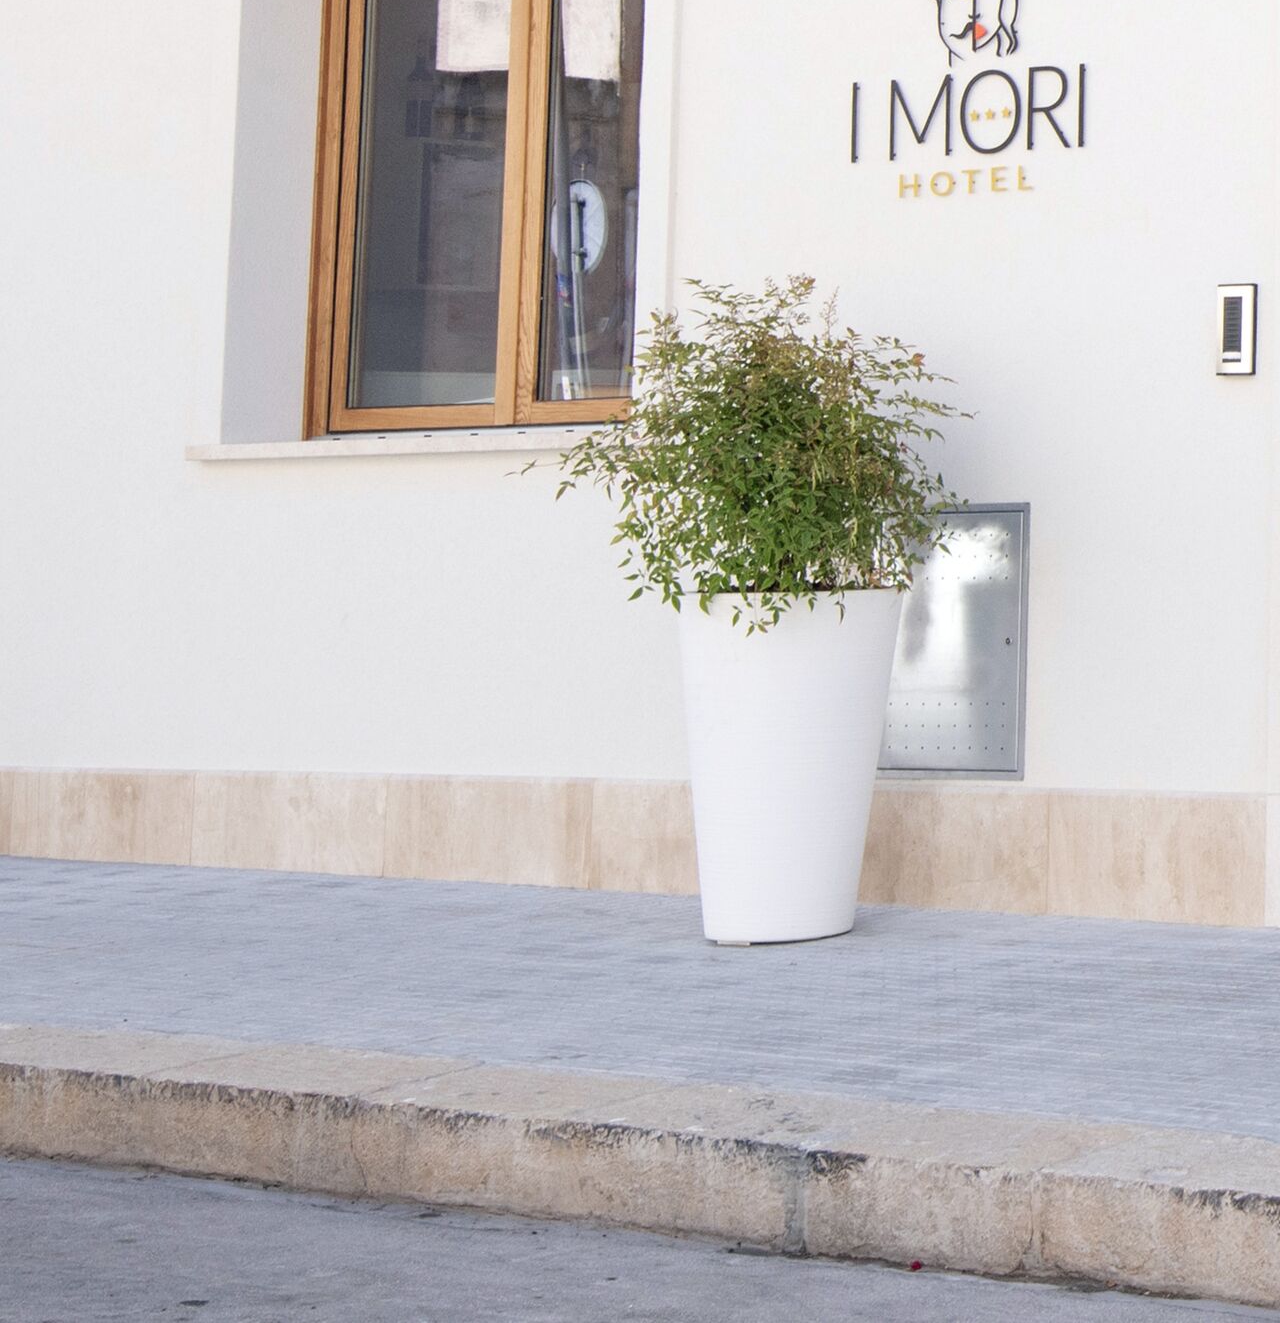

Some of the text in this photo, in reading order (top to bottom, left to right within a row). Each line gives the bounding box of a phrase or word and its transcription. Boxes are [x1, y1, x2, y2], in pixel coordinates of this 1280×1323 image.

[851, 63, 1087, 163] I MORI
[898, 164, 1034, 198] HOTEL
